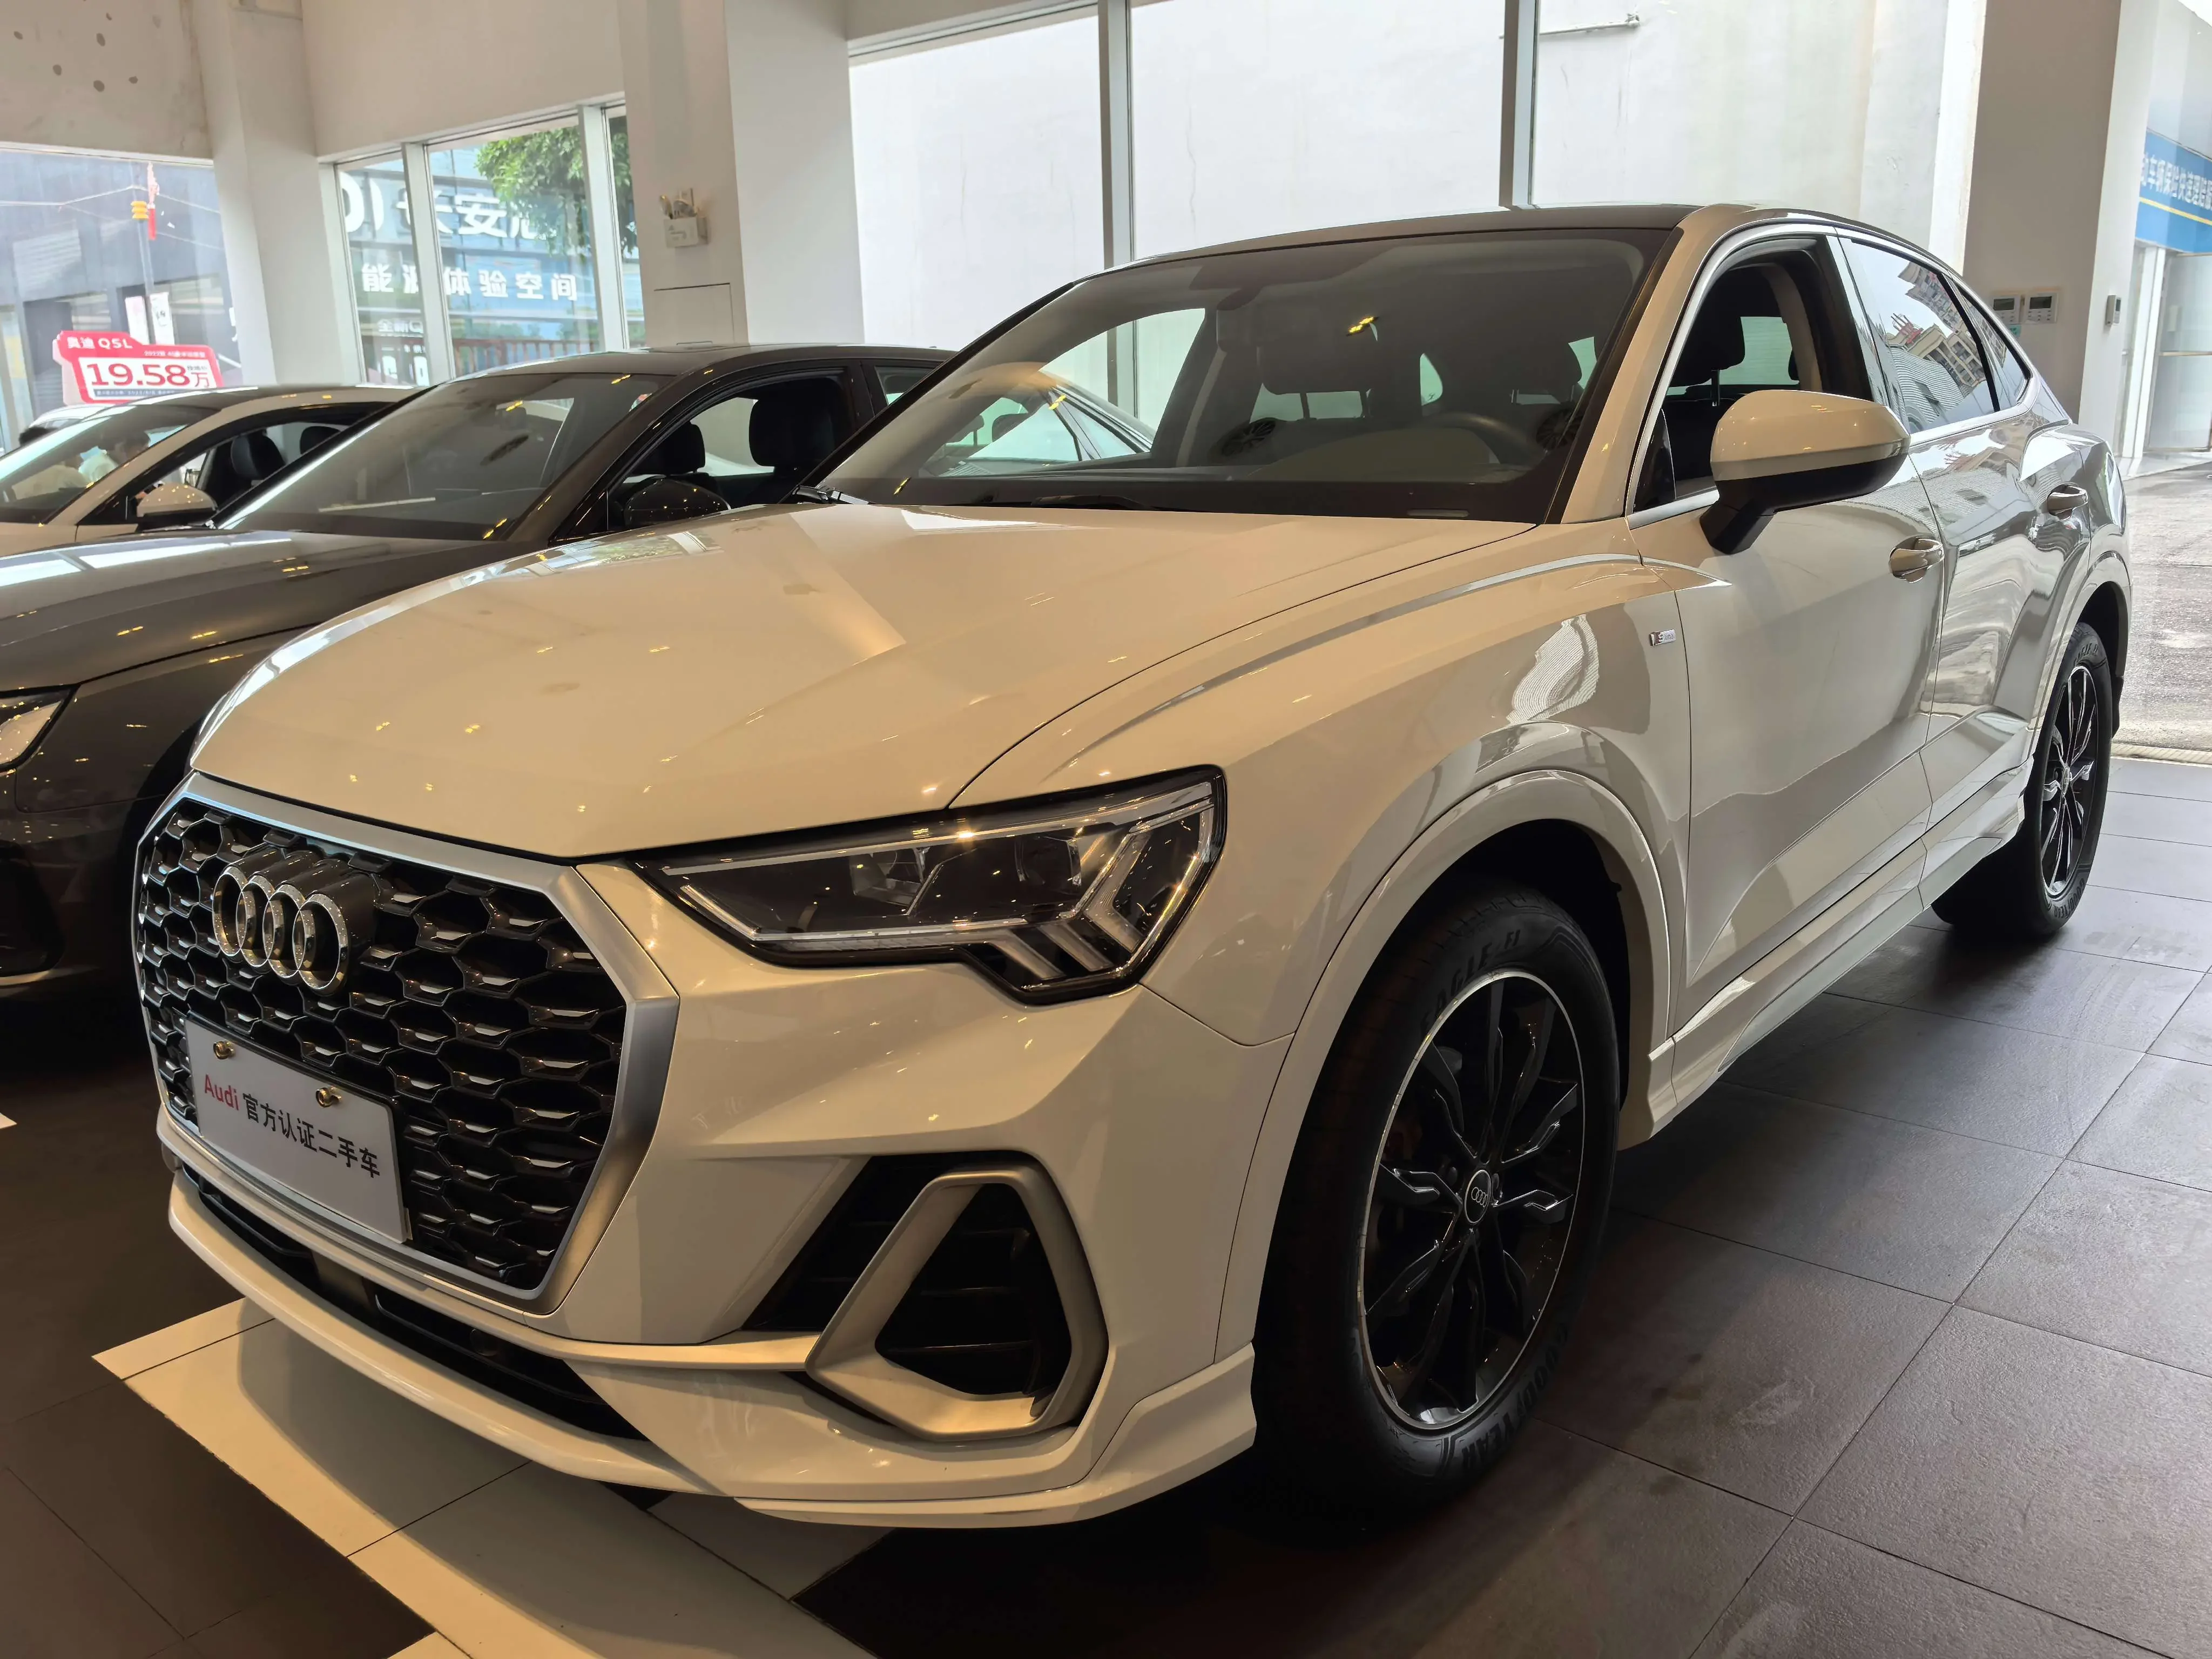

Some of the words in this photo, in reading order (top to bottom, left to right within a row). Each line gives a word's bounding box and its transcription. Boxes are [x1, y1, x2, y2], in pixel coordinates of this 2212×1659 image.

[98, 337, 133, 350] Q5L
[204, 1073, 239, 1111] Audi
[242, 1092, 381, 1178] 官方认证二手车
